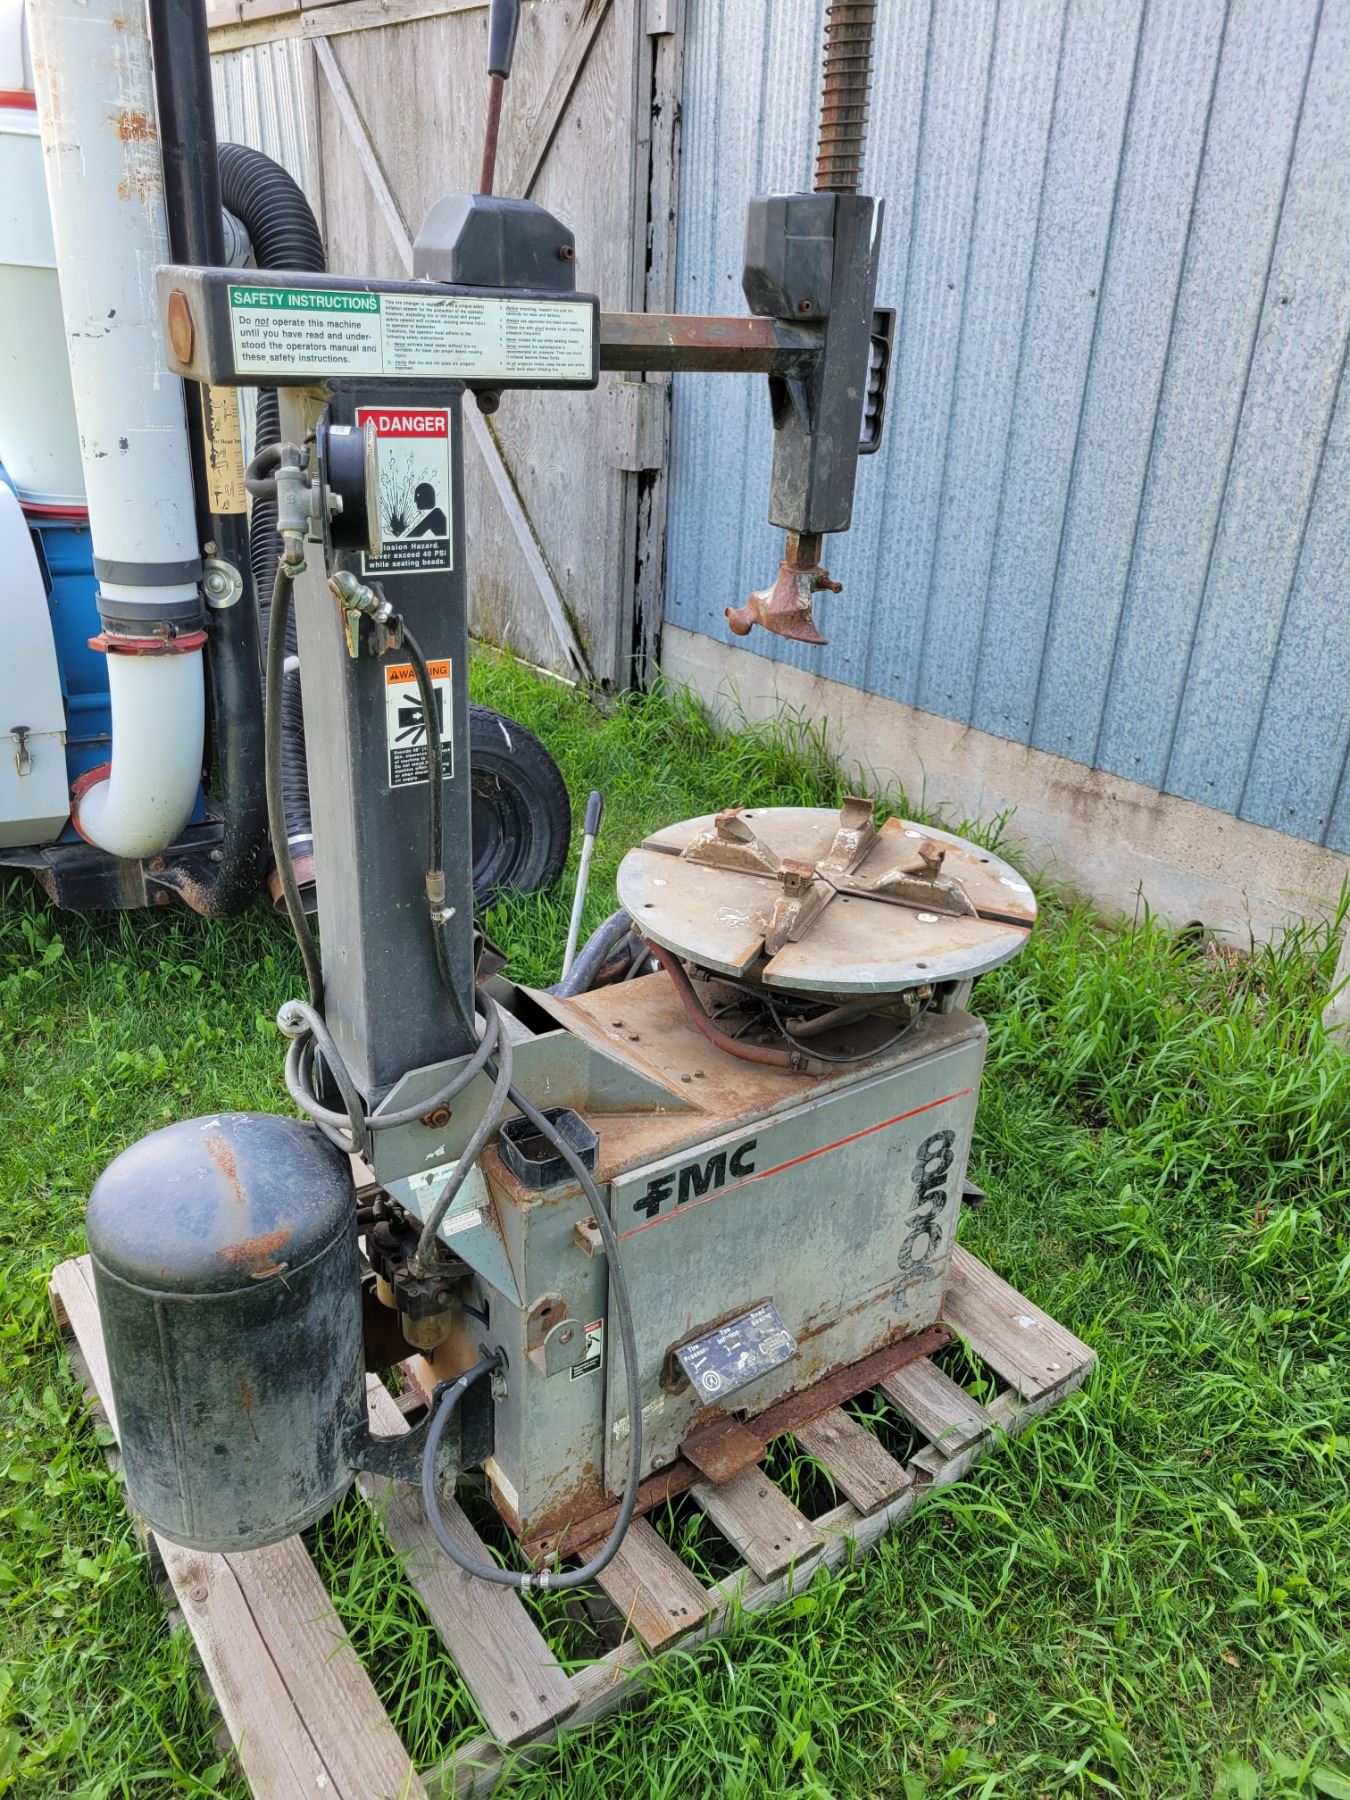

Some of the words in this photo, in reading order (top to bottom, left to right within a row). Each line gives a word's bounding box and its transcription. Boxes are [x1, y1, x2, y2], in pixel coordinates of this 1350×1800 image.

[234, 292, 283, 305] SAFETY
[288, 294, 378, 310] INSTRUCTIONS
[239, 316, 251, 325] Do
[254, 317, 270, 327] not
[272, 319, 305, 328] operate
[308, 319, 324, 328] this
[326, 320, 361, 329] machine
[240, 328, 260, 337] until
[263, 331, 279, 339] you
[282, 330, 302, 338] have
[305, 331, 324, 339] read
[327, 331, 343, 340] and
[345, 332, 372, 341] under-
[241, 341, 266, 349] stood
[269, 341, 283, 350] the
[286, 343, 327, 352] operators
[329, 343, 360, 352] manual
[361, 344, 377, 353] and
[242, 352, 267, 361] these
[269, 353, 296, 363] safety
[298, 354, 351, 364] instructions.
[378, 416, 446, 432] DANGER
[411, 542, 440, 550] Hazard.
[393, 551, 420, 559] exceed
[392, 560, 420, 568] seating
[399, 665, 448, 679] WAING
[632, 1139, 757, 1219] FMC
